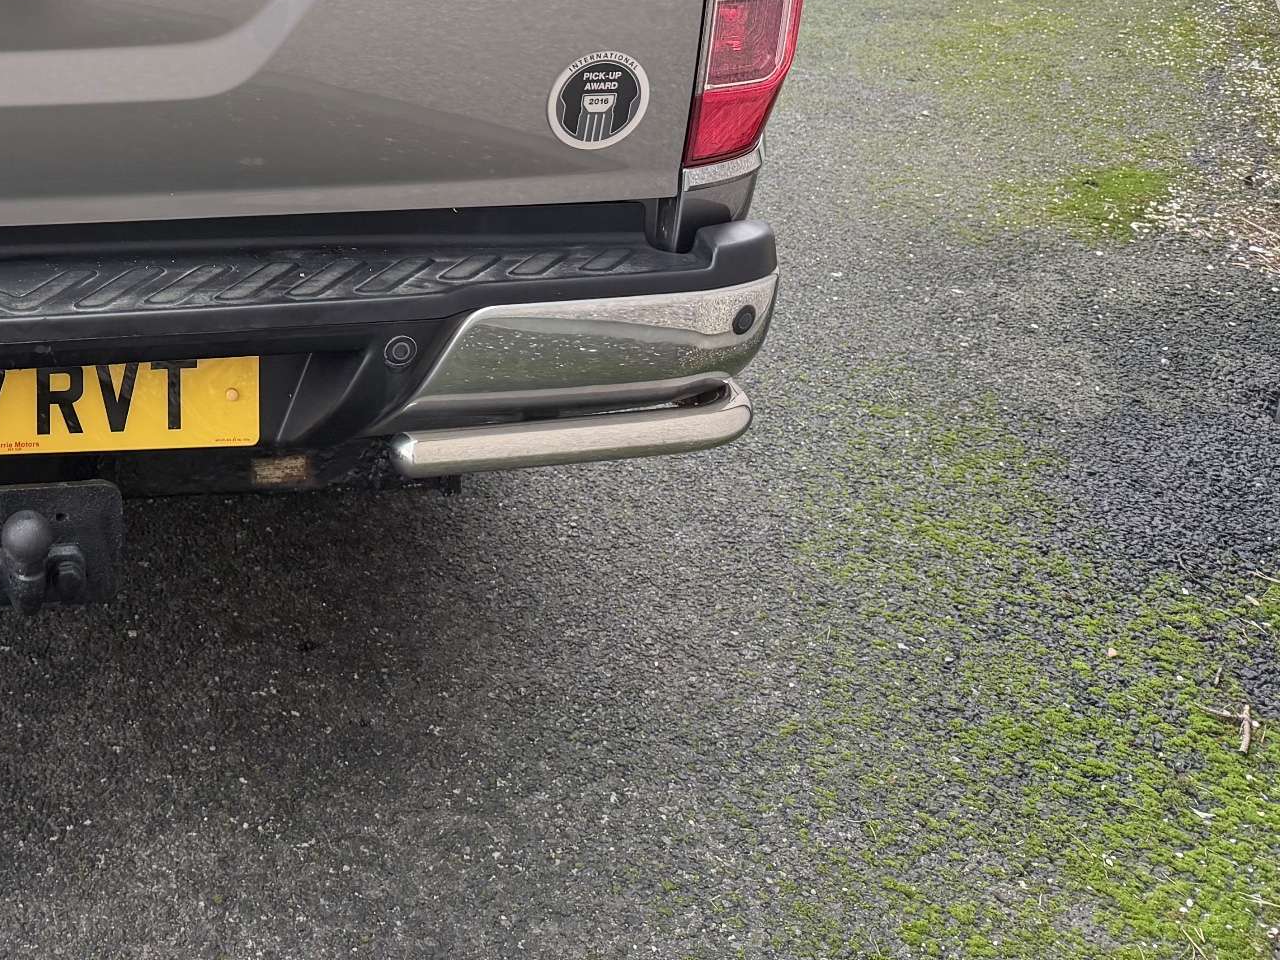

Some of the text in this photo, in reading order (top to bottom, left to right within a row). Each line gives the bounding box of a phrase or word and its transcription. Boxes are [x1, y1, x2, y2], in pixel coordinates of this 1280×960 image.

[568, 52, 639, 72] INTERNATIONAL
[583, 71, 622, 81] PICK-UP
[584, 81, 619, 91] AWARD
[588, 97, 609, 106] 2016
[36, 360, 198, 436] RVT
